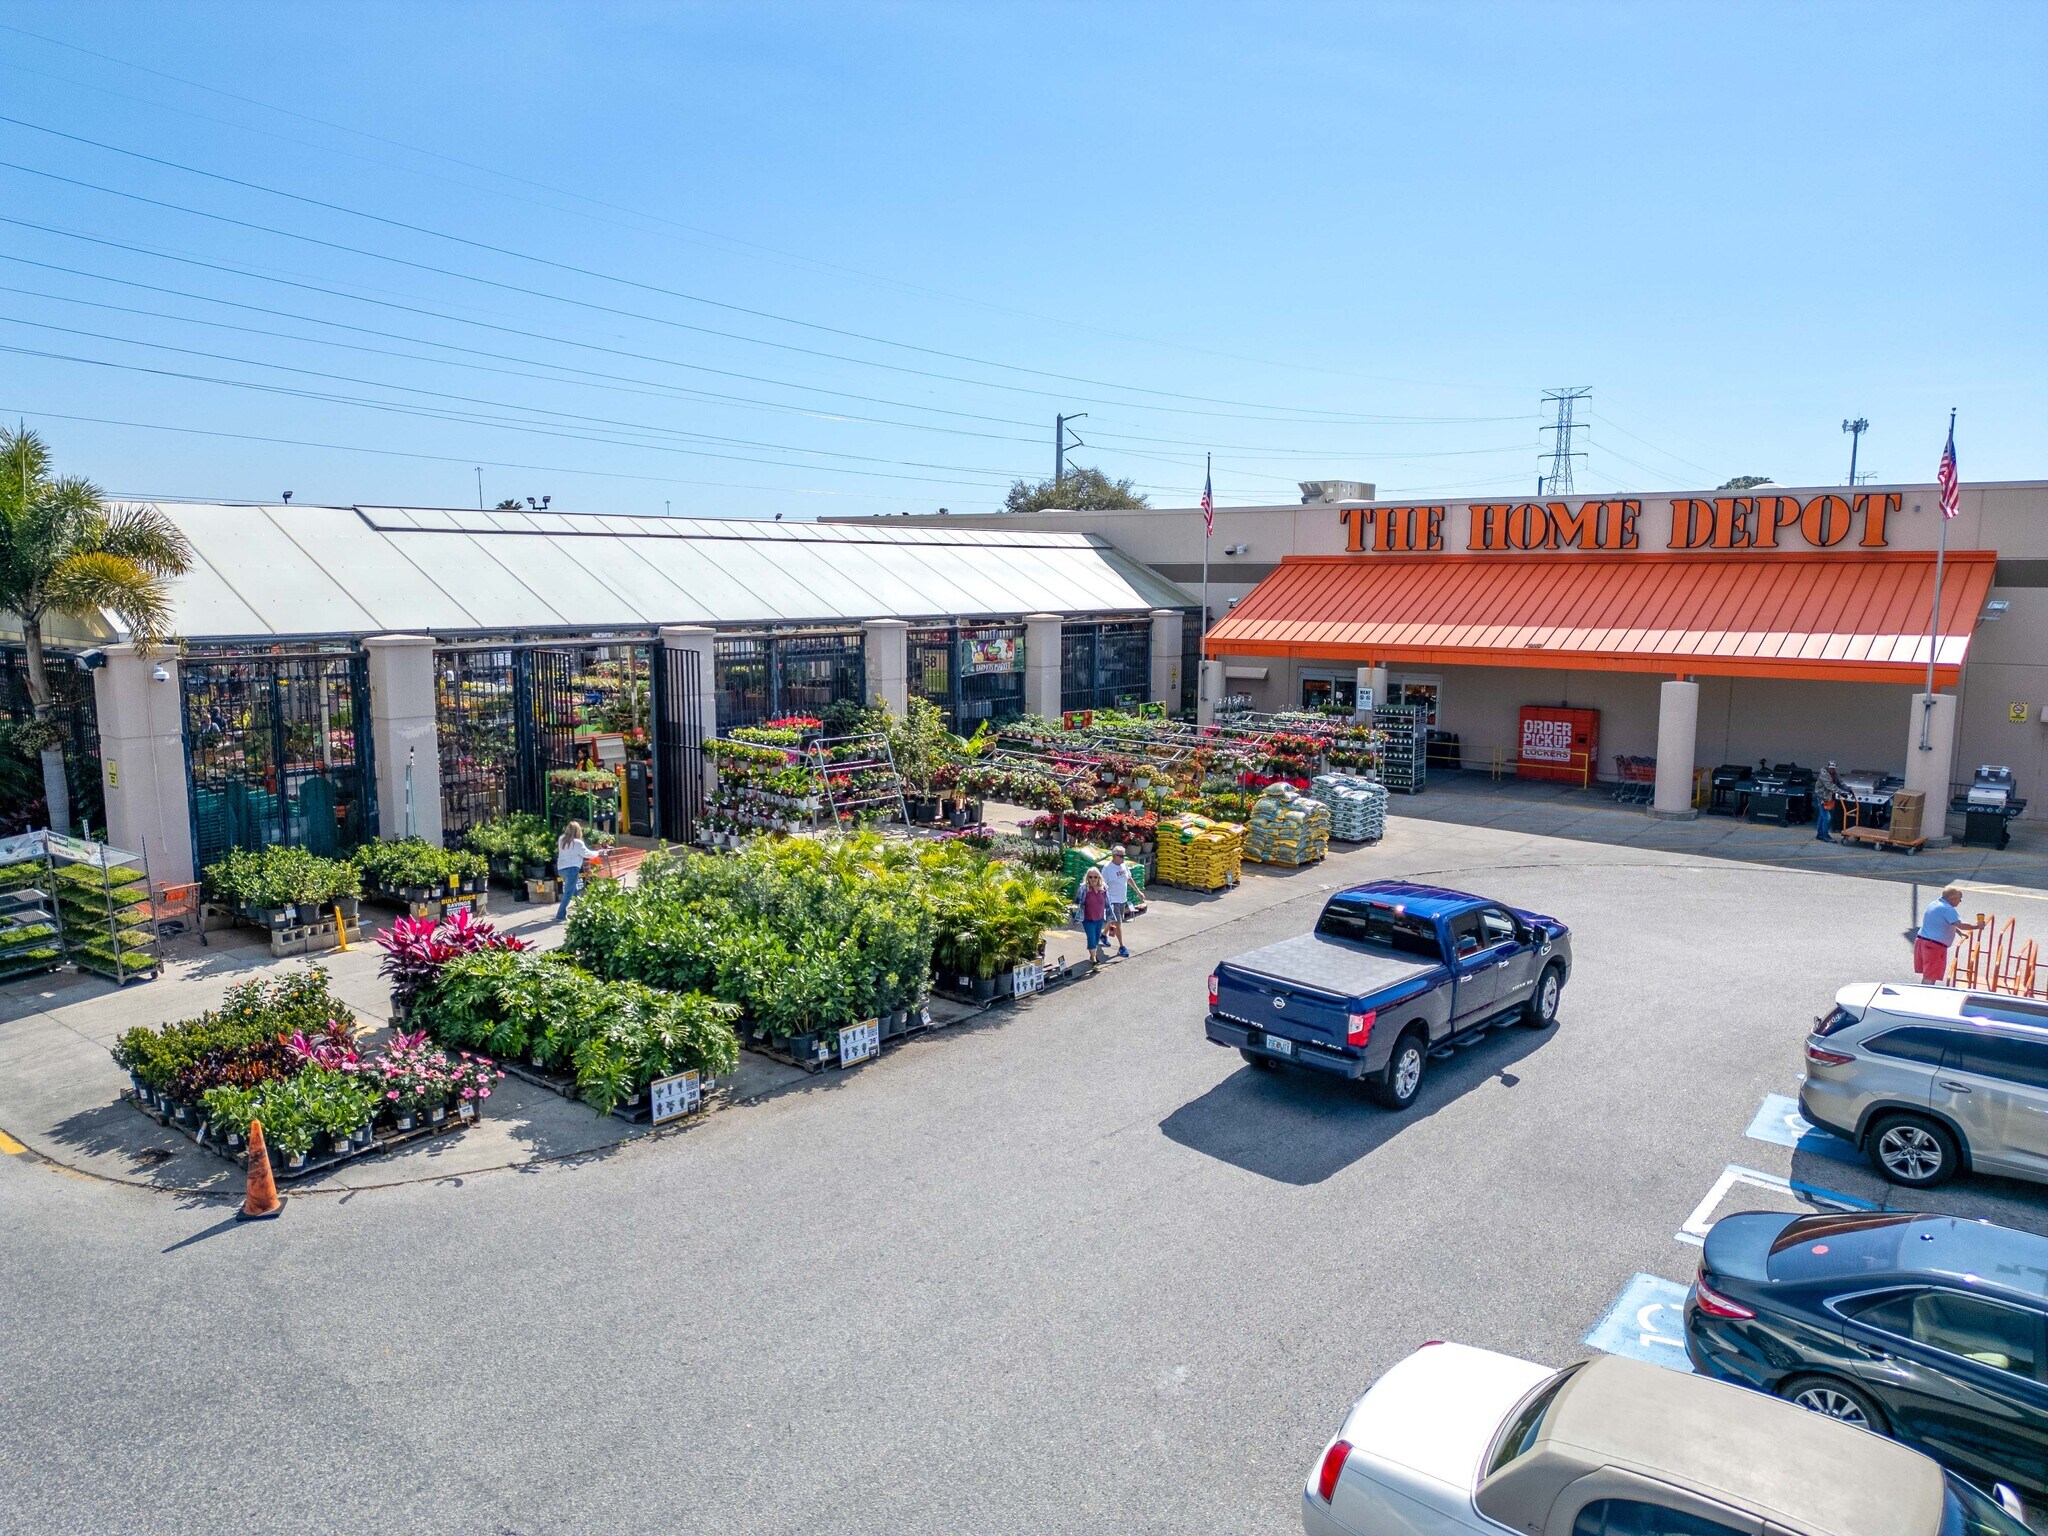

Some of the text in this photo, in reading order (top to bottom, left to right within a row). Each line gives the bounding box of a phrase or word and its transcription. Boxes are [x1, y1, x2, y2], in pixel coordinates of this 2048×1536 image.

[1340, 493, 1902, 552] THE HOME DEPOT
[1523, 719, 1572, 736] ORDER
[1523, 732, 1572, 748] PICKUP
[1525, 749, 1569, 758] LOCKERS
[441, 894, 476, 905] BULK PRICE
[1219, 1011, 1248, 1023] TITAN
